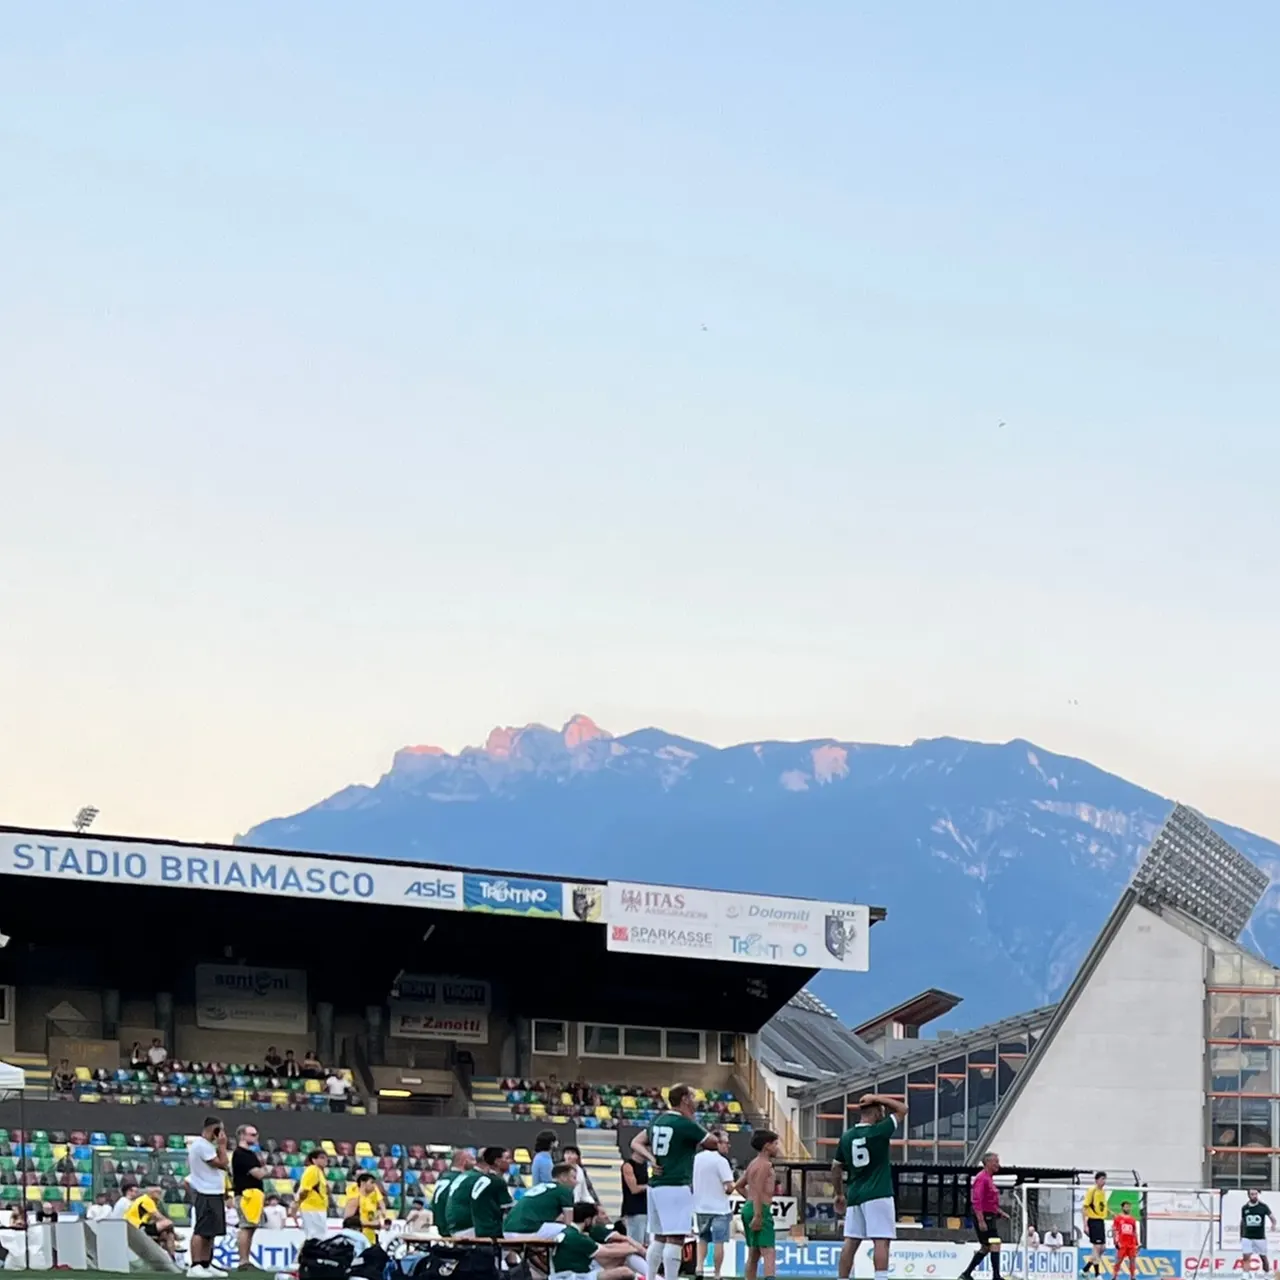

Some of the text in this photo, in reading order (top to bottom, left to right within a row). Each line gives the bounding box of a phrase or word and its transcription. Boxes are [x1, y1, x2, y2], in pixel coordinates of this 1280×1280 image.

[13, 843, 375, 898] STADIO BRIAMASCO
[645, 891, 686, 910] ITAS
[748, 904, 810, 921] Dolomiti
[630, 925, 713, 944] SPARKASSE
[651, 1125, 674, 1156] 13
[851, 1137, 870, 1168] 6
[889, 1248, 957, 1261] ruppo Activa
[1232, 1257, 1278, 1271] ACI
